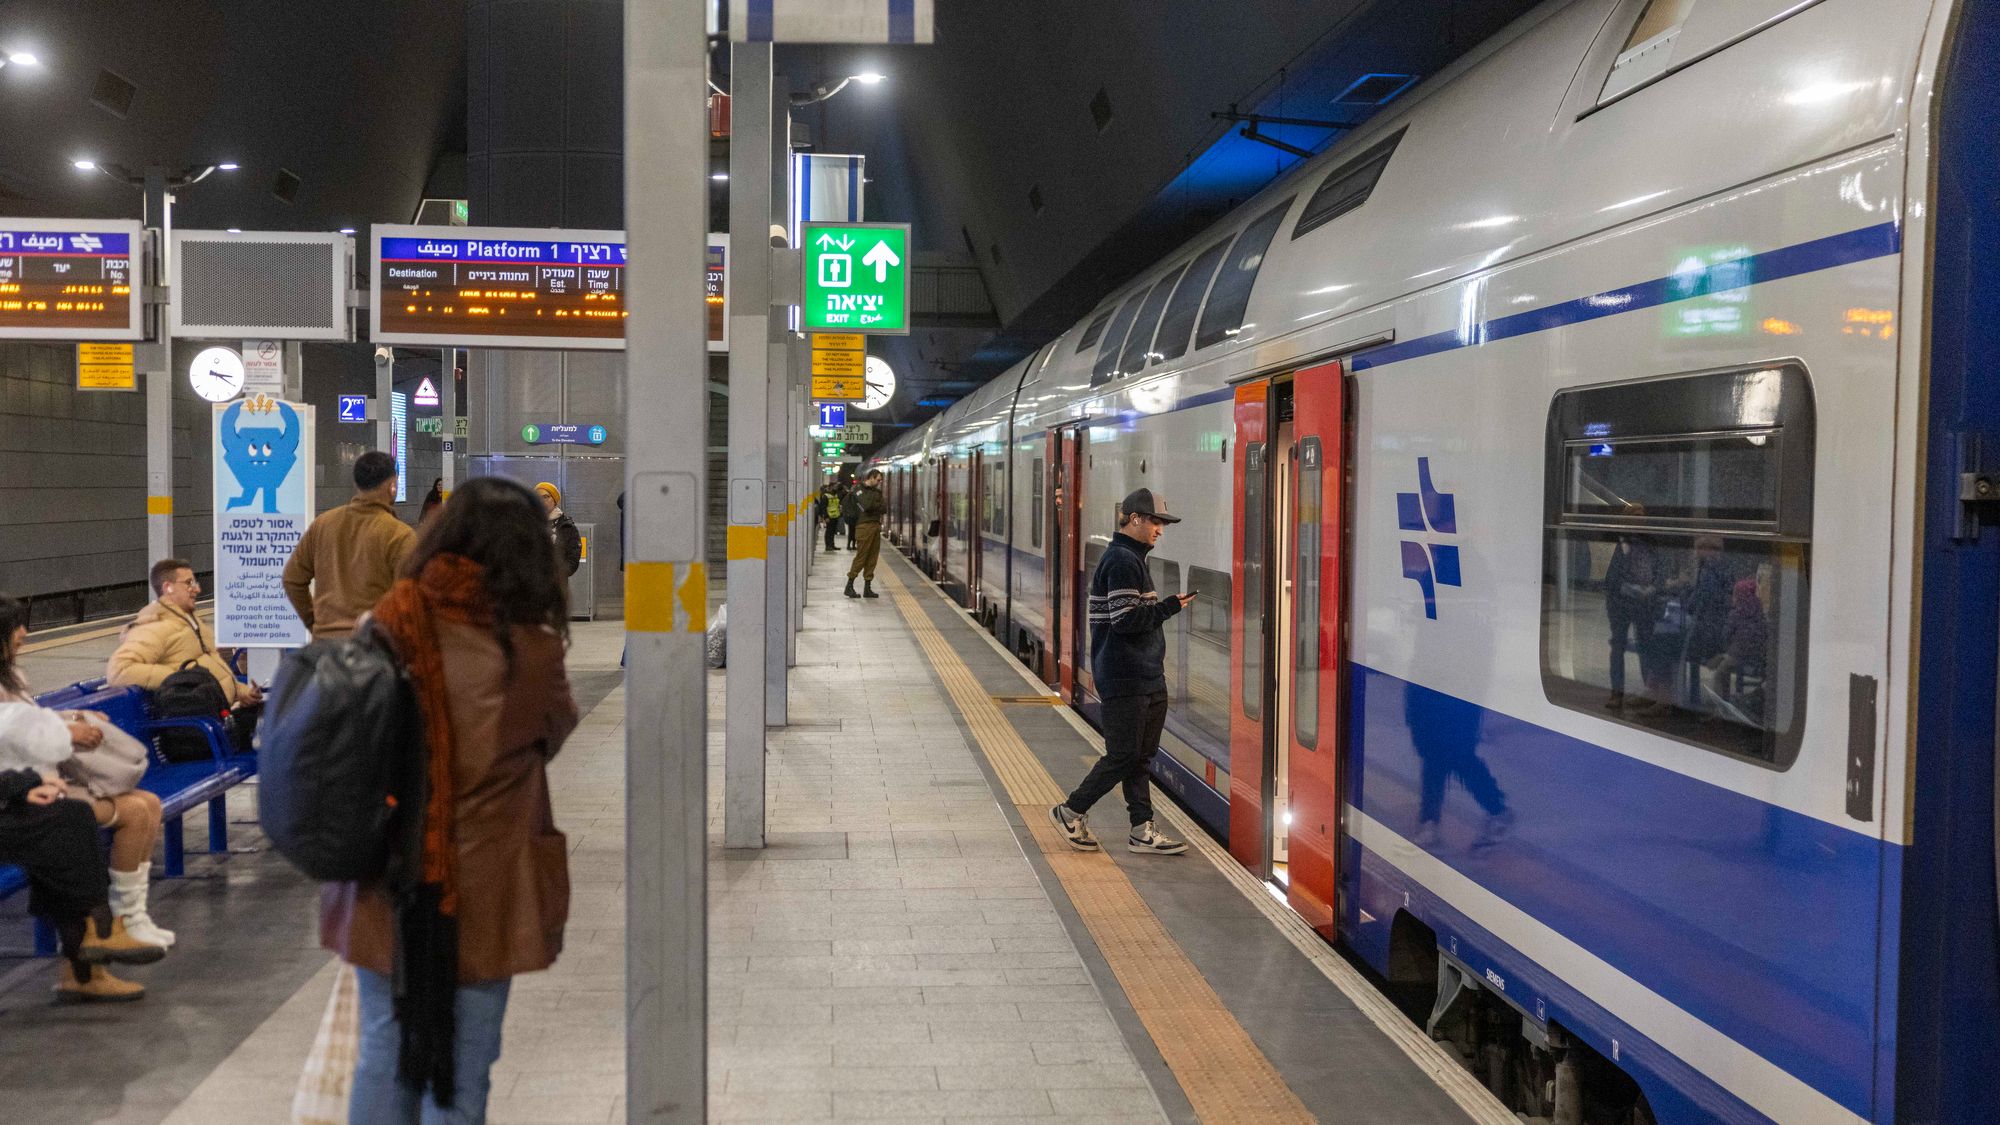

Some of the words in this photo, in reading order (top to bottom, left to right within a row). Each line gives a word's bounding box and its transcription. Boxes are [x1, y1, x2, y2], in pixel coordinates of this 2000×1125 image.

[22, 233, 63, 251] رصيف
[418, 240, 458, 258] رصيف
[467, 241, 540, 258] Platform
[550, 243, 558, 259] 1
[570, 244, 611, 264] רציף
[53, 264, 71, 273] יעד
[106, 259, 129, 269] רכבת
[110, 270, 124, 280] No.
[389, 267, 438, 279] Destination
[468, 270, 497, 281] ביניים
[498, 271, 530, 282] תחנות
[541, 267, 575, 280] מעודכן
[587, 268, 610, 280] שעה
[707, 272, 723, 282] רכב
[550, 278, 566, 289] Est.
[587, 279, 609, 290] Time
[827, 294, 884, 311] יציאה
[826, 313, 850, 323] EXIT
[341, 398, 353, 417] 2
[821, 405, 831, 423] 1
[445, 442, 452, 451] B
[266, 519, 293, 529] אסור
[221, 530, 253, 541] ולגעת
[256, 531, 301, 543] להתקרב
[222, 544, 253, 554] עמודי
[256, 545, 267, 554] או
[1486, 967, 1505, 991] SIEMENS
[1612, 1038, 1619, 1062] 1R
